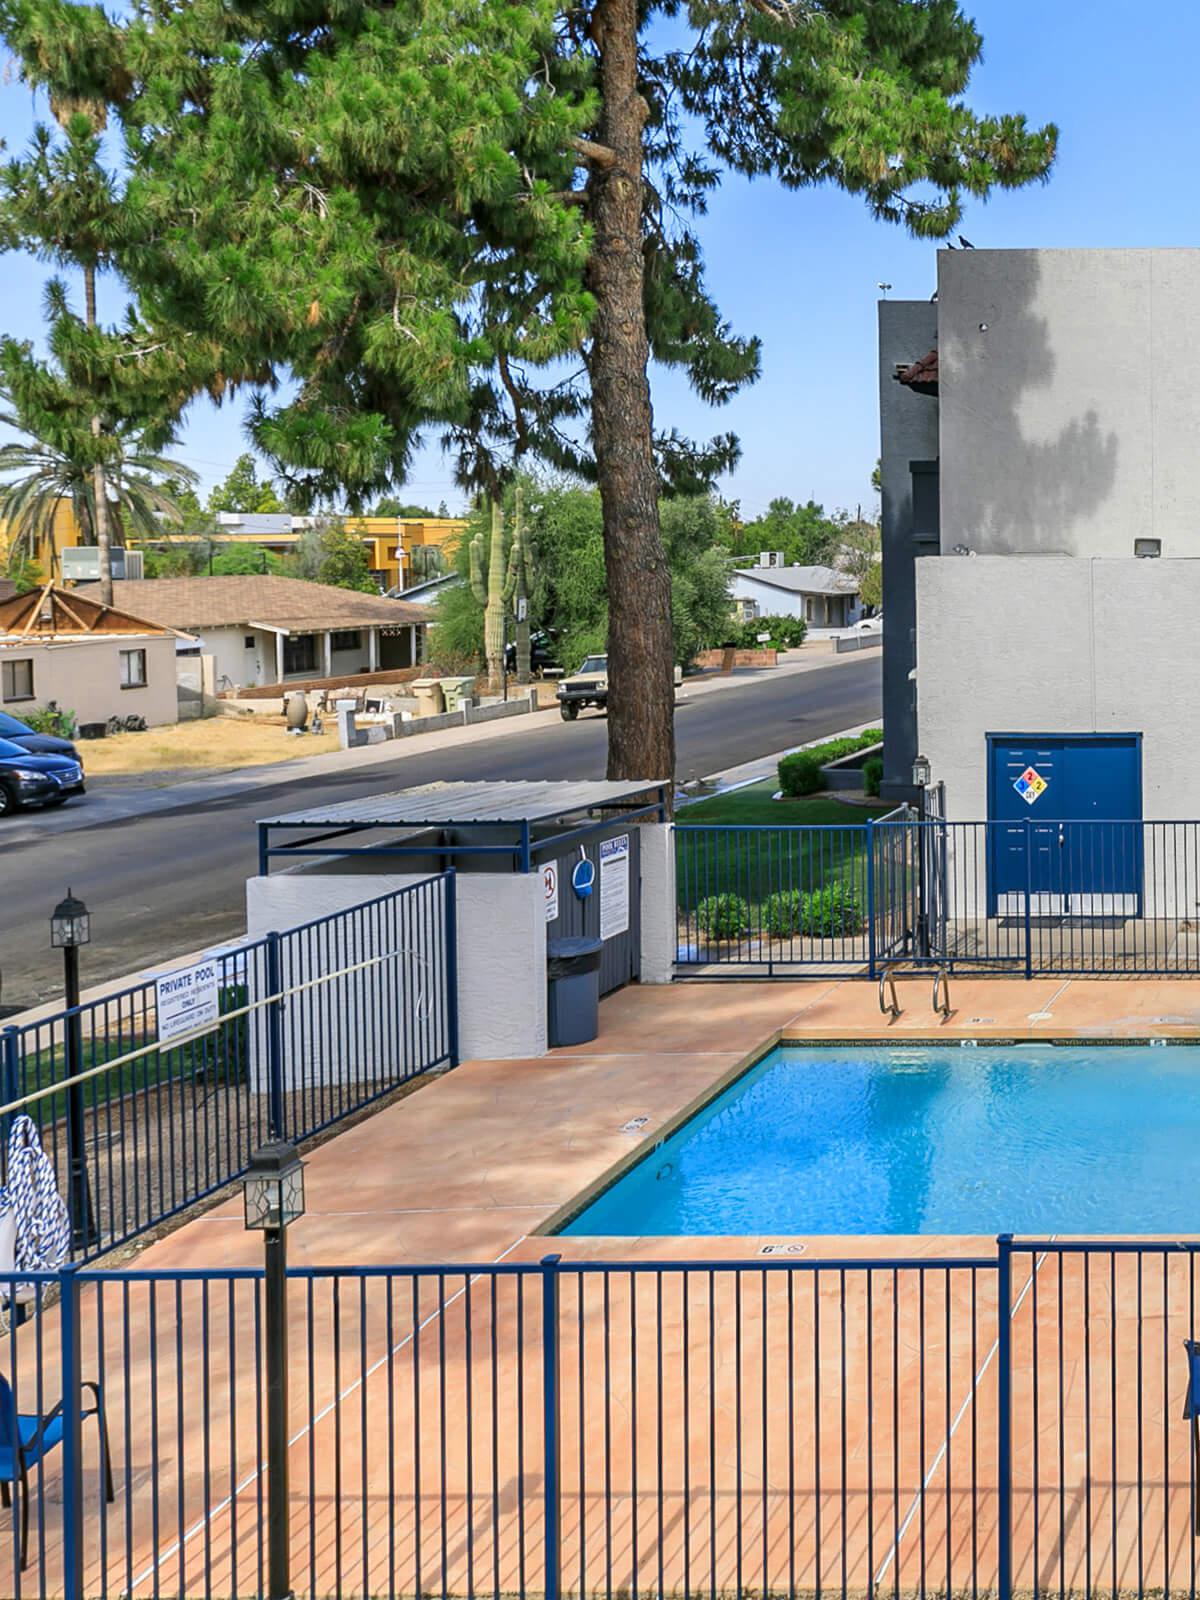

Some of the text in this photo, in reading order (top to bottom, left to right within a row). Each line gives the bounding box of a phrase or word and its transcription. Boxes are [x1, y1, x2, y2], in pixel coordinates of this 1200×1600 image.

[1027, 771, 1033, 781] 2
[1036, 781, 1042, 790] 2
[160, 966, 215, 996] PRIVATE POOL
[182, 998, 196, 1009] ONLY
